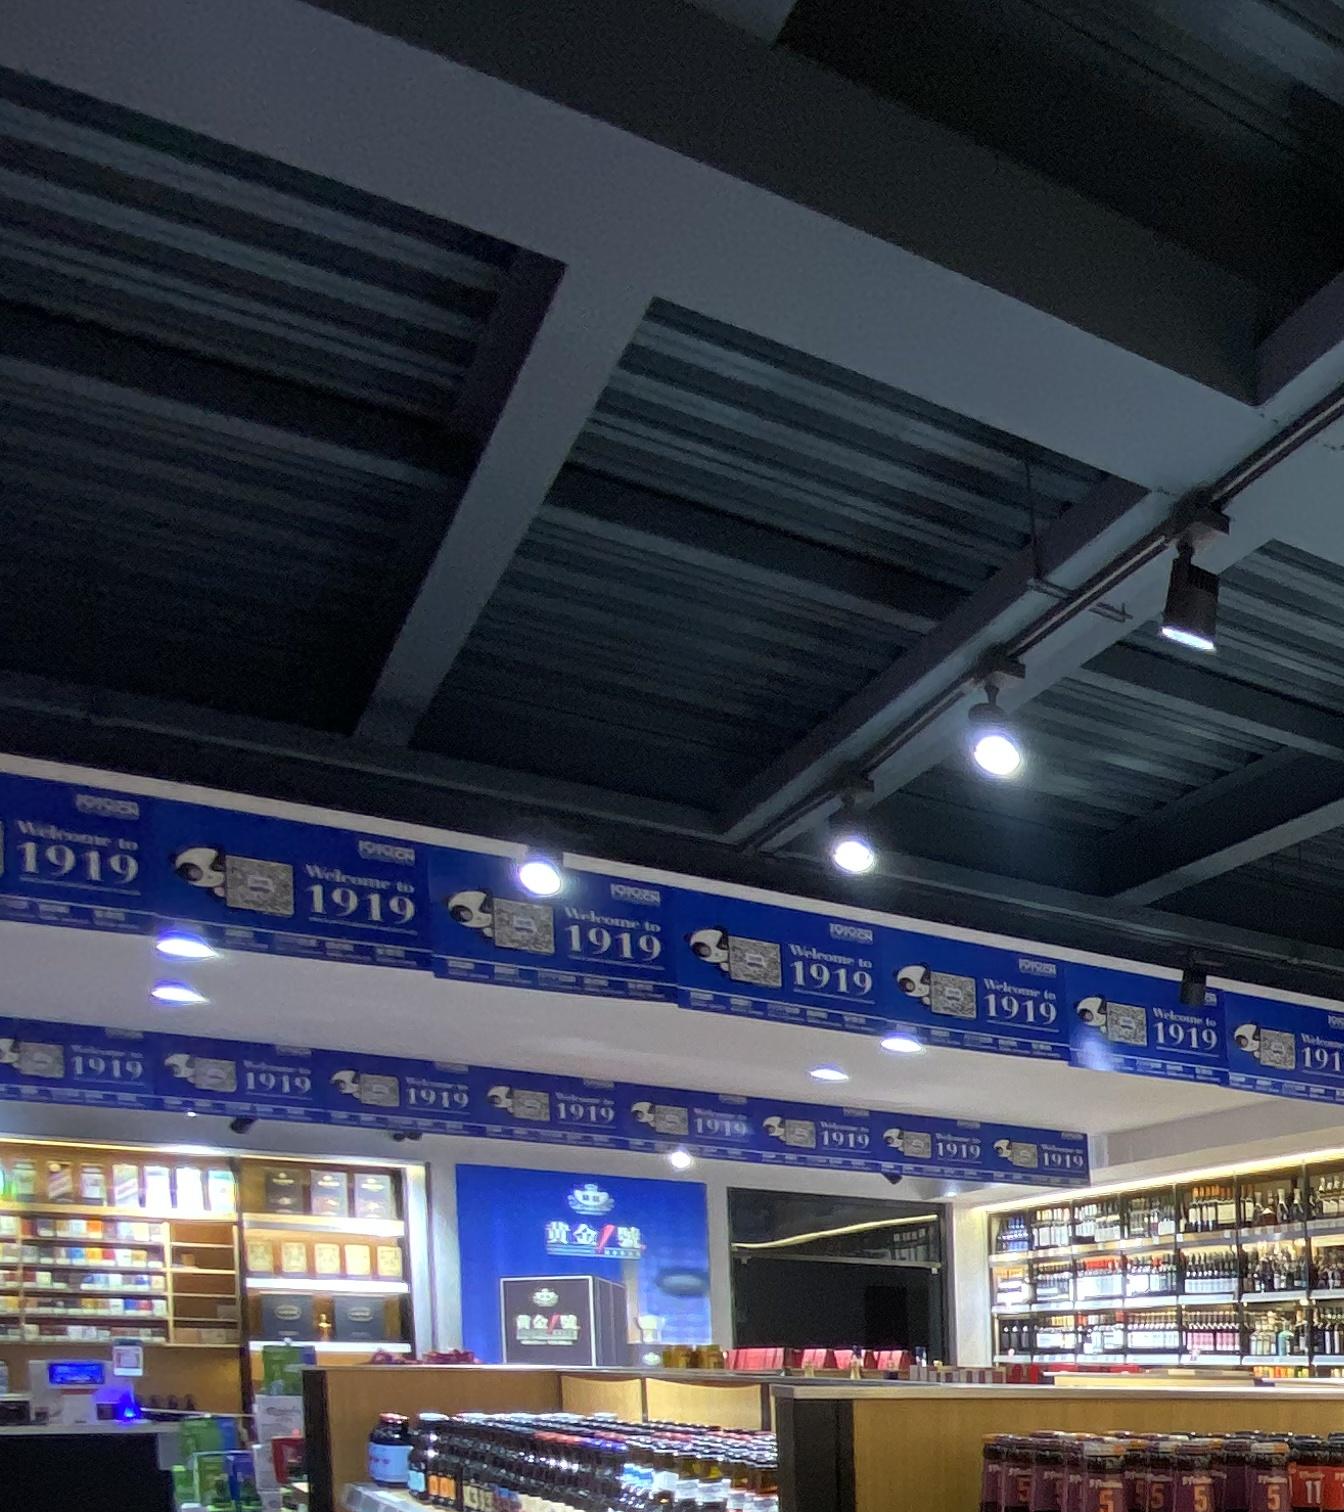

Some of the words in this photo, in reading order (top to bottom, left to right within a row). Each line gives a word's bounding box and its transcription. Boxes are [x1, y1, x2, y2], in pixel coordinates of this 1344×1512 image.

[118, 838, 138, 851] to
[17, 841, 139, 884] 1919
[397, 880, 414, 893] to
[308, 883, 416, 924] 1919
[645, 921, 661, 932] to
[565, 925, 662, 961] 1919
[859, 958, 872, 969] to
[790, 961, 872, 995] 1919
[1044, 990, 1056, 1000] to
[984, 993, 1057, 1025] 1919
[1206, 1017, 1216, 1027] to
[1153, 1021, 1217, 1050] 1919
[72, 1055, 143, 1079] 1919
[245, 1071, 311, 1094] 1919
[408, 1087, 469, 1109] 1919
[557, 1101, 614, 1123] 1919
[695, 1116, 747, 1137] 1919
[821, 1129, 870, 1150] 1919
[936, 1141, 981, 1160] 1919
[1042, 1150, 1084, 1168] 1919
[1194, 1485, 1209, 1512] 5
[1267, 1485, 1281, 1511] 5
